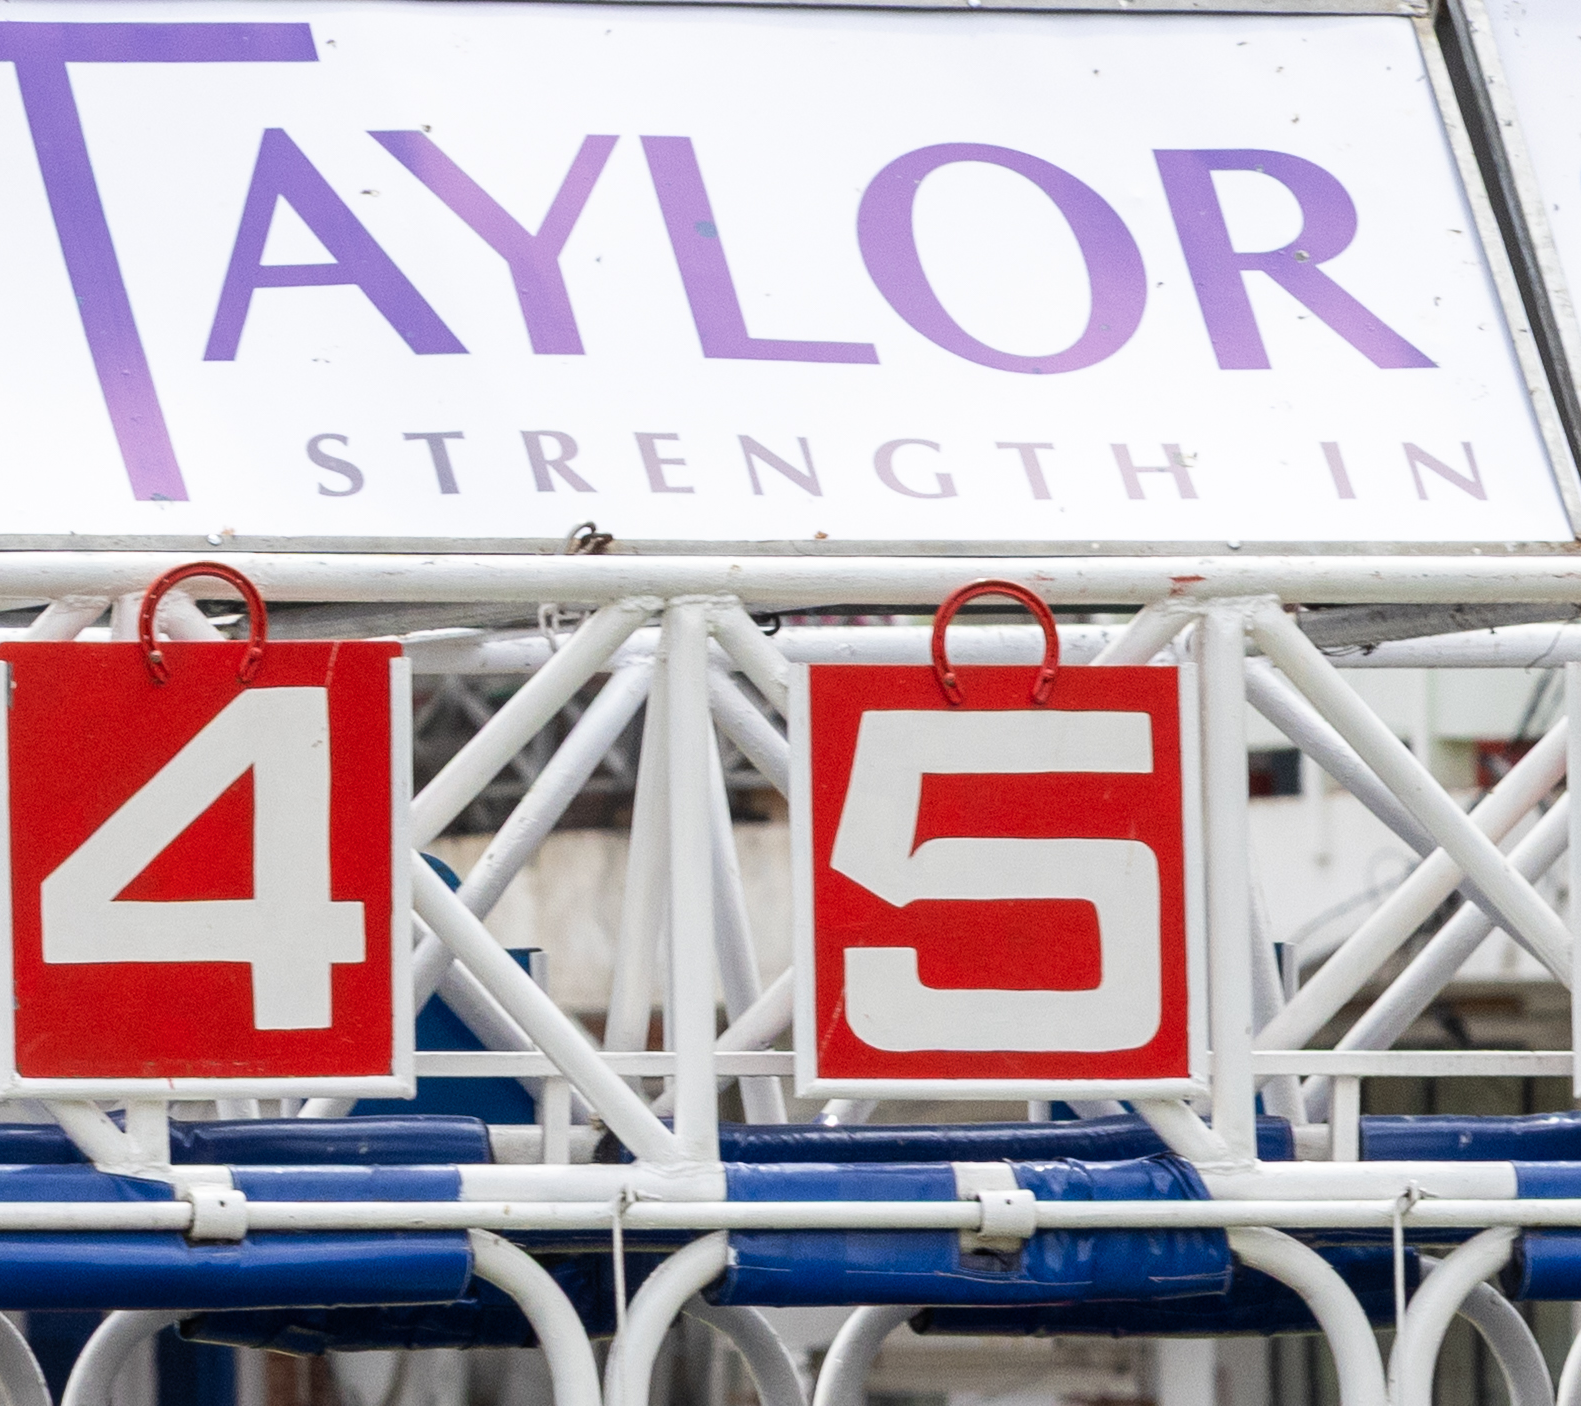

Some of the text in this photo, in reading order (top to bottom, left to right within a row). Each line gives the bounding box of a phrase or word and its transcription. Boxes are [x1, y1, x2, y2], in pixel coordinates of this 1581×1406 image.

[305, 429, 1203, 503] STRENGTH
[1321, 438, 1490, 503] IN
[40, 686, 366, 1031] 4
[830, 709, 1162, 1054] 5
